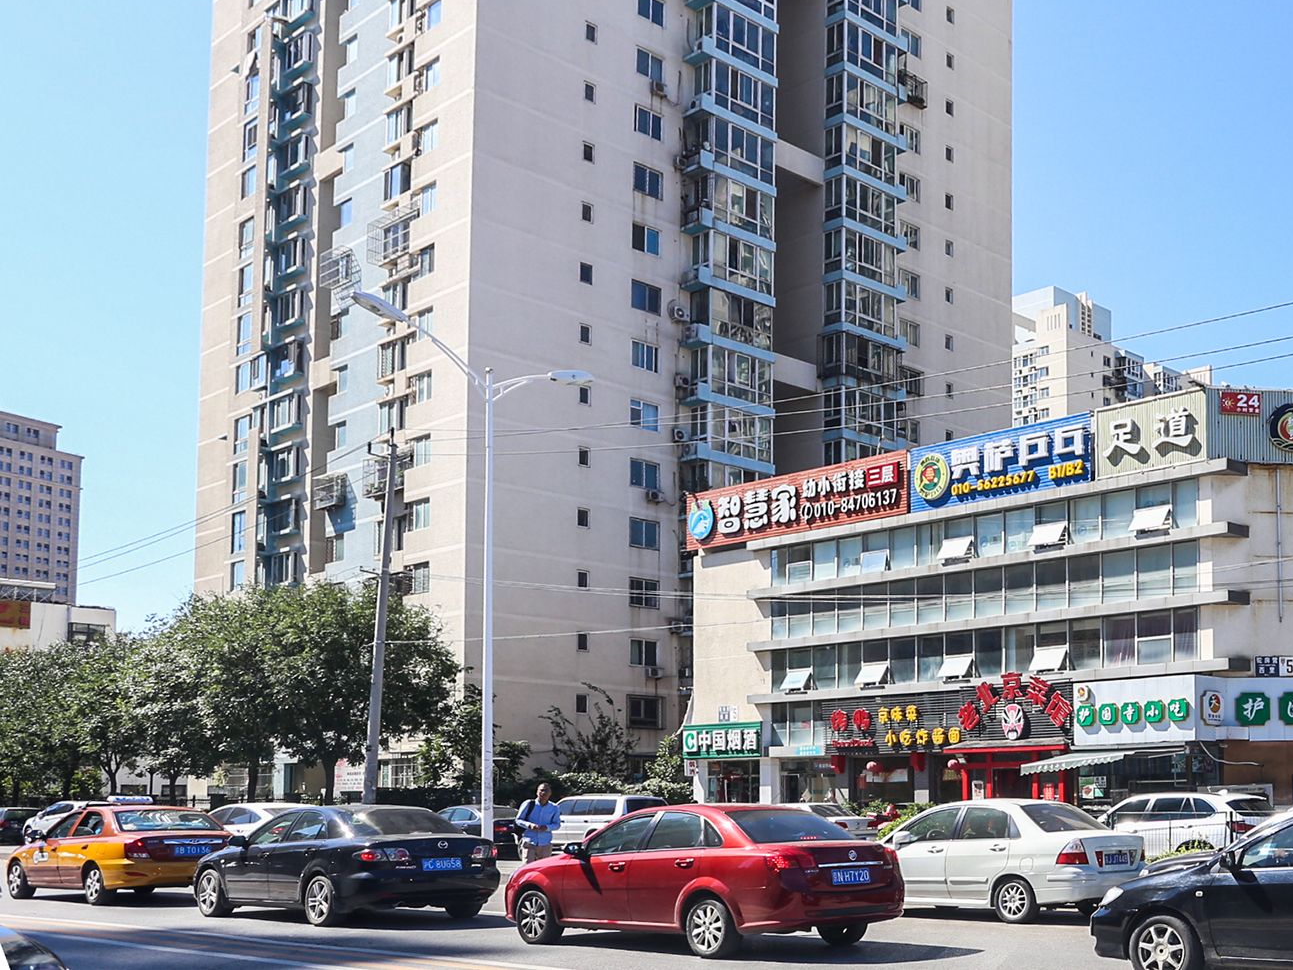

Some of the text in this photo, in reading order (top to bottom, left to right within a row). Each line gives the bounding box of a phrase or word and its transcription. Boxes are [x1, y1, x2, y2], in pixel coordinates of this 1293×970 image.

[1236, 394, 1260, 408] 24
[1103, 406, 1196, 458] 足道
[951, 424, 1087, 479] 奥萨乒乓
[801, 468, 867, 498] 幼小衔接
[867, 465, 895, 486] 三层
[951, 470, 1036, 496] 010-56225677
[1048, 459, 1084, 480] B1/B2
[717, 484, 797, 534] 智慧家
[814, 488, 898, 518] 010-84706137
[1286, 659, 1293, 674] 5
[877, 705, 920, 724] 京味菜
[957, 671, 1074, 731] 老北京菜馆
[1077, 700, 1187, 726] 护国寺小吃
[698, 729, 757, 751] 中国烟酒
[885, 727, 962, 747] 小吃炸酱面
